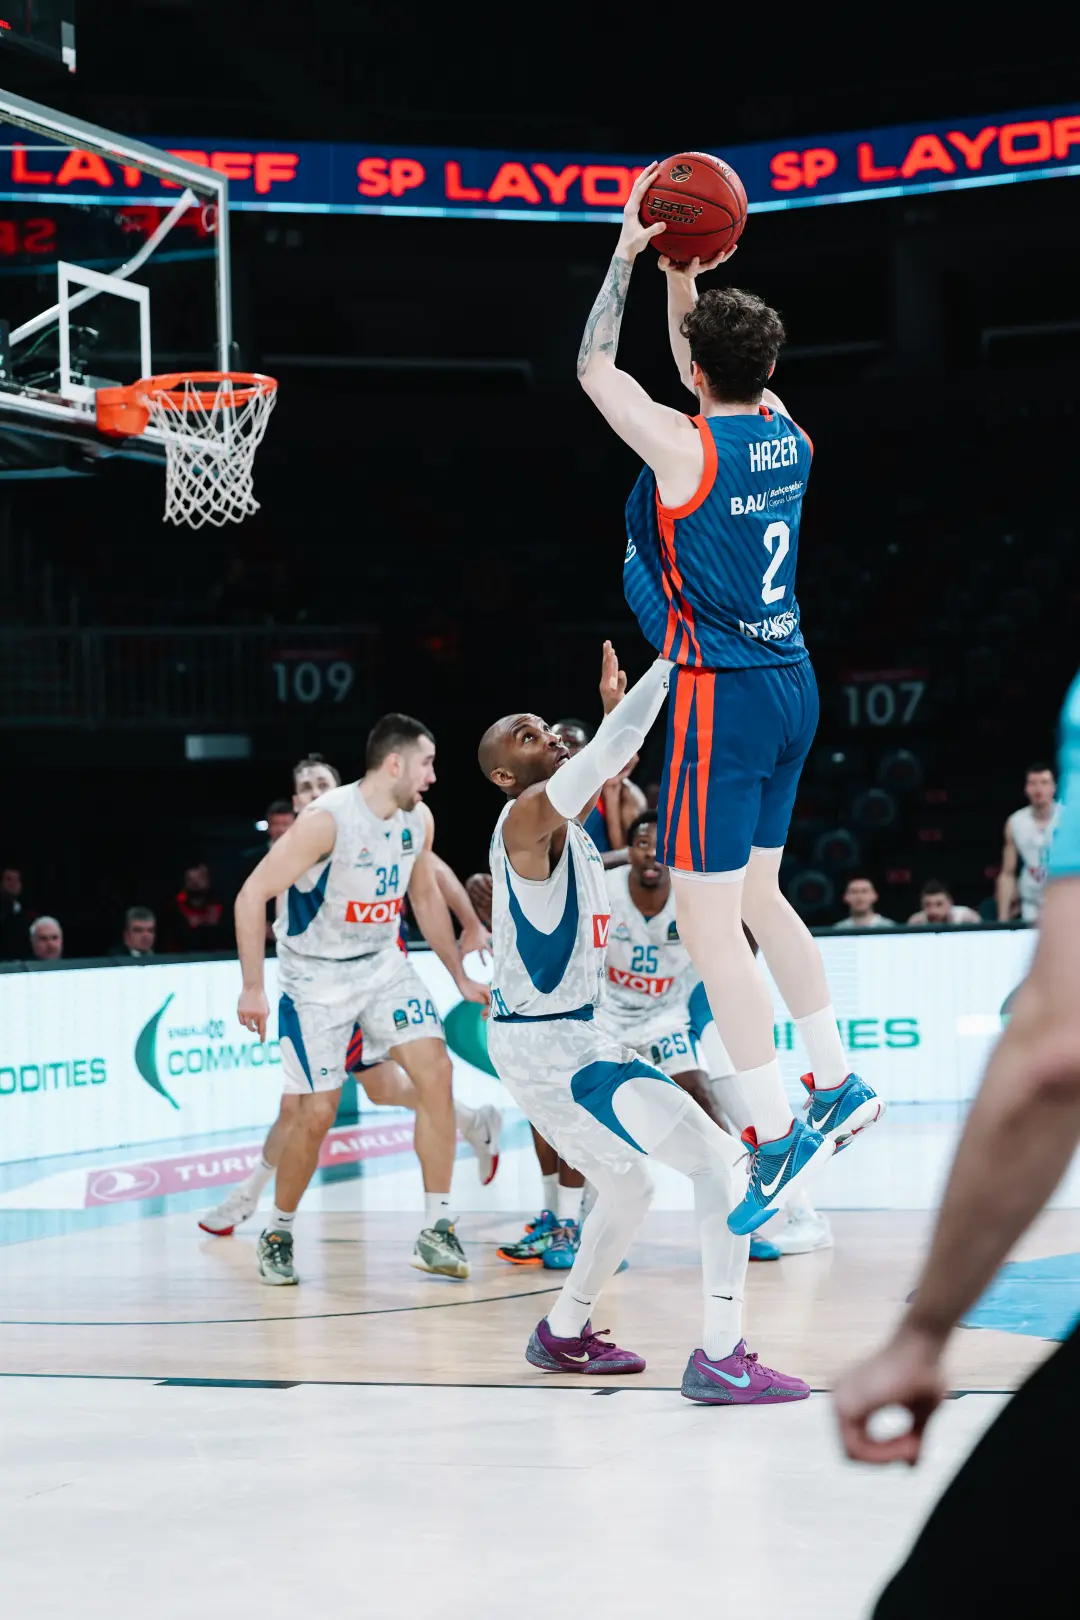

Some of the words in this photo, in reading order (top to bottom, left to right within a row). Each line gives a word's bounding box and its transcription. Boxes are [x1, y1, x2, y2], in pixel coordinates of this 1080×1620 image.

[646, 194, 703, 219] LEGACY
[748, 435, 799, 473] HAZER
[730, 491, 767, 516] BAU
[761, 520, 790, 606] 2
[271, 660, 355, 703] 109
[842, 681, 927, 726] 107
[375, 864, 399, 896] 34
[631, 945, 659, 974] 25
[407, 998, 438, 1025] 34
[660, 1032, 688, 1059] 25
